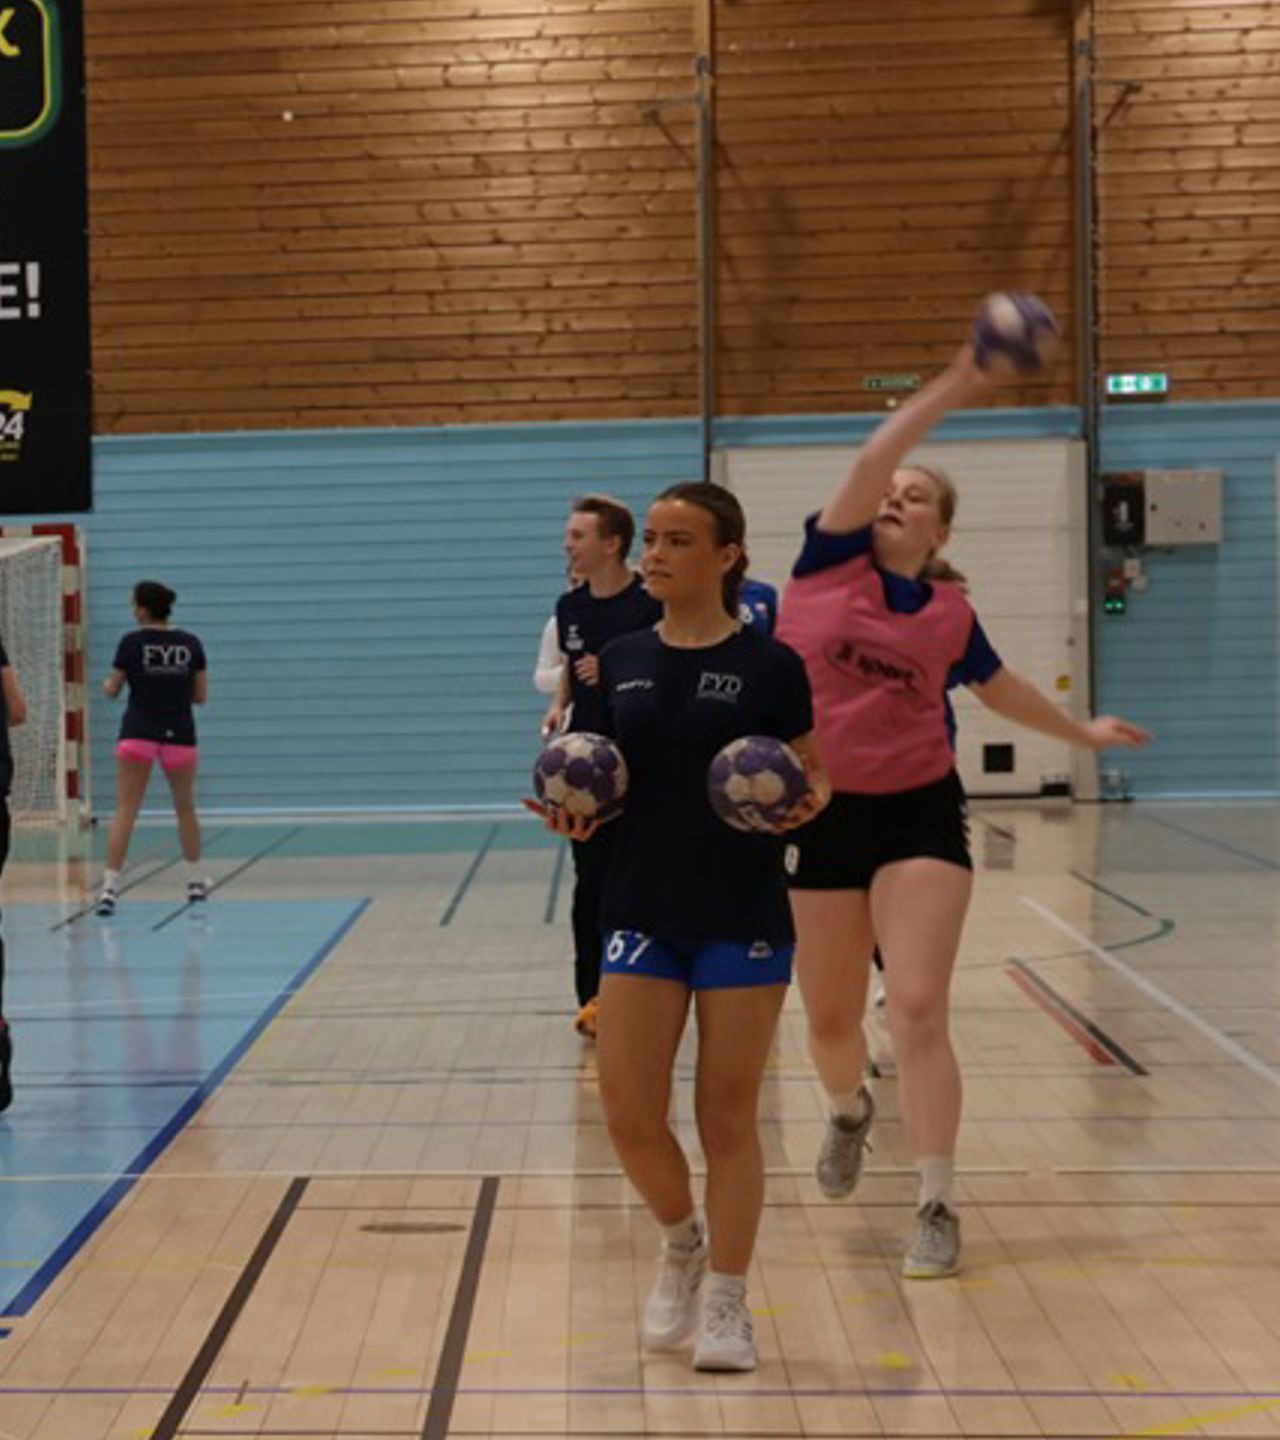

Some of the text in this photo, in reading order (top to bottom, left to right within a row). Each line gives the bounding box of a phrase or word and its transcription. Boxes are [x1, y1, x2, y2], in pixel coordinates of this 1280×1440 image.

[141, 644, 192, 666] FYD
[698, 671, 743, 696] FYD
[605, 929, 653, 966] 67
